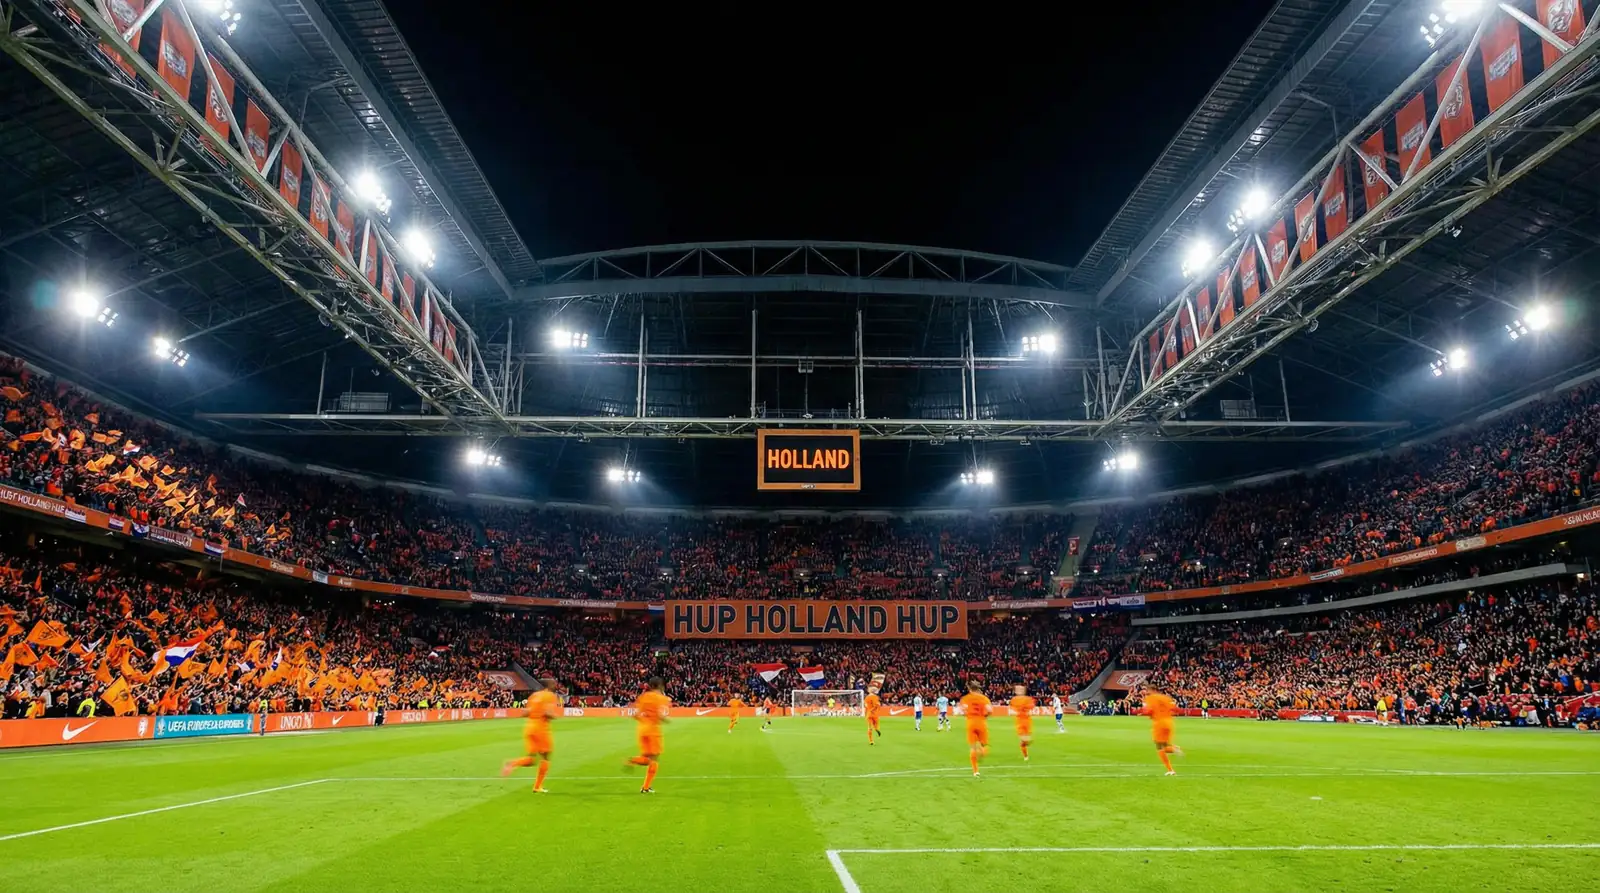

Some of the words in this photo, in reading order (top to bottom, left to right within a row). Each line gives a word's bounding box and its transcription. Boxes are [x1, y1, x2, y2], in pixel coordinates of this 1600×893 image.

[767, 448, 850, 469] HOLLAND
[673, 604, 736, 635] HUP
[744, 604, 889, 635] HOLLAND
[896, 604, 960, 635] HUP
[167, 720, 187, 732] UEFA
